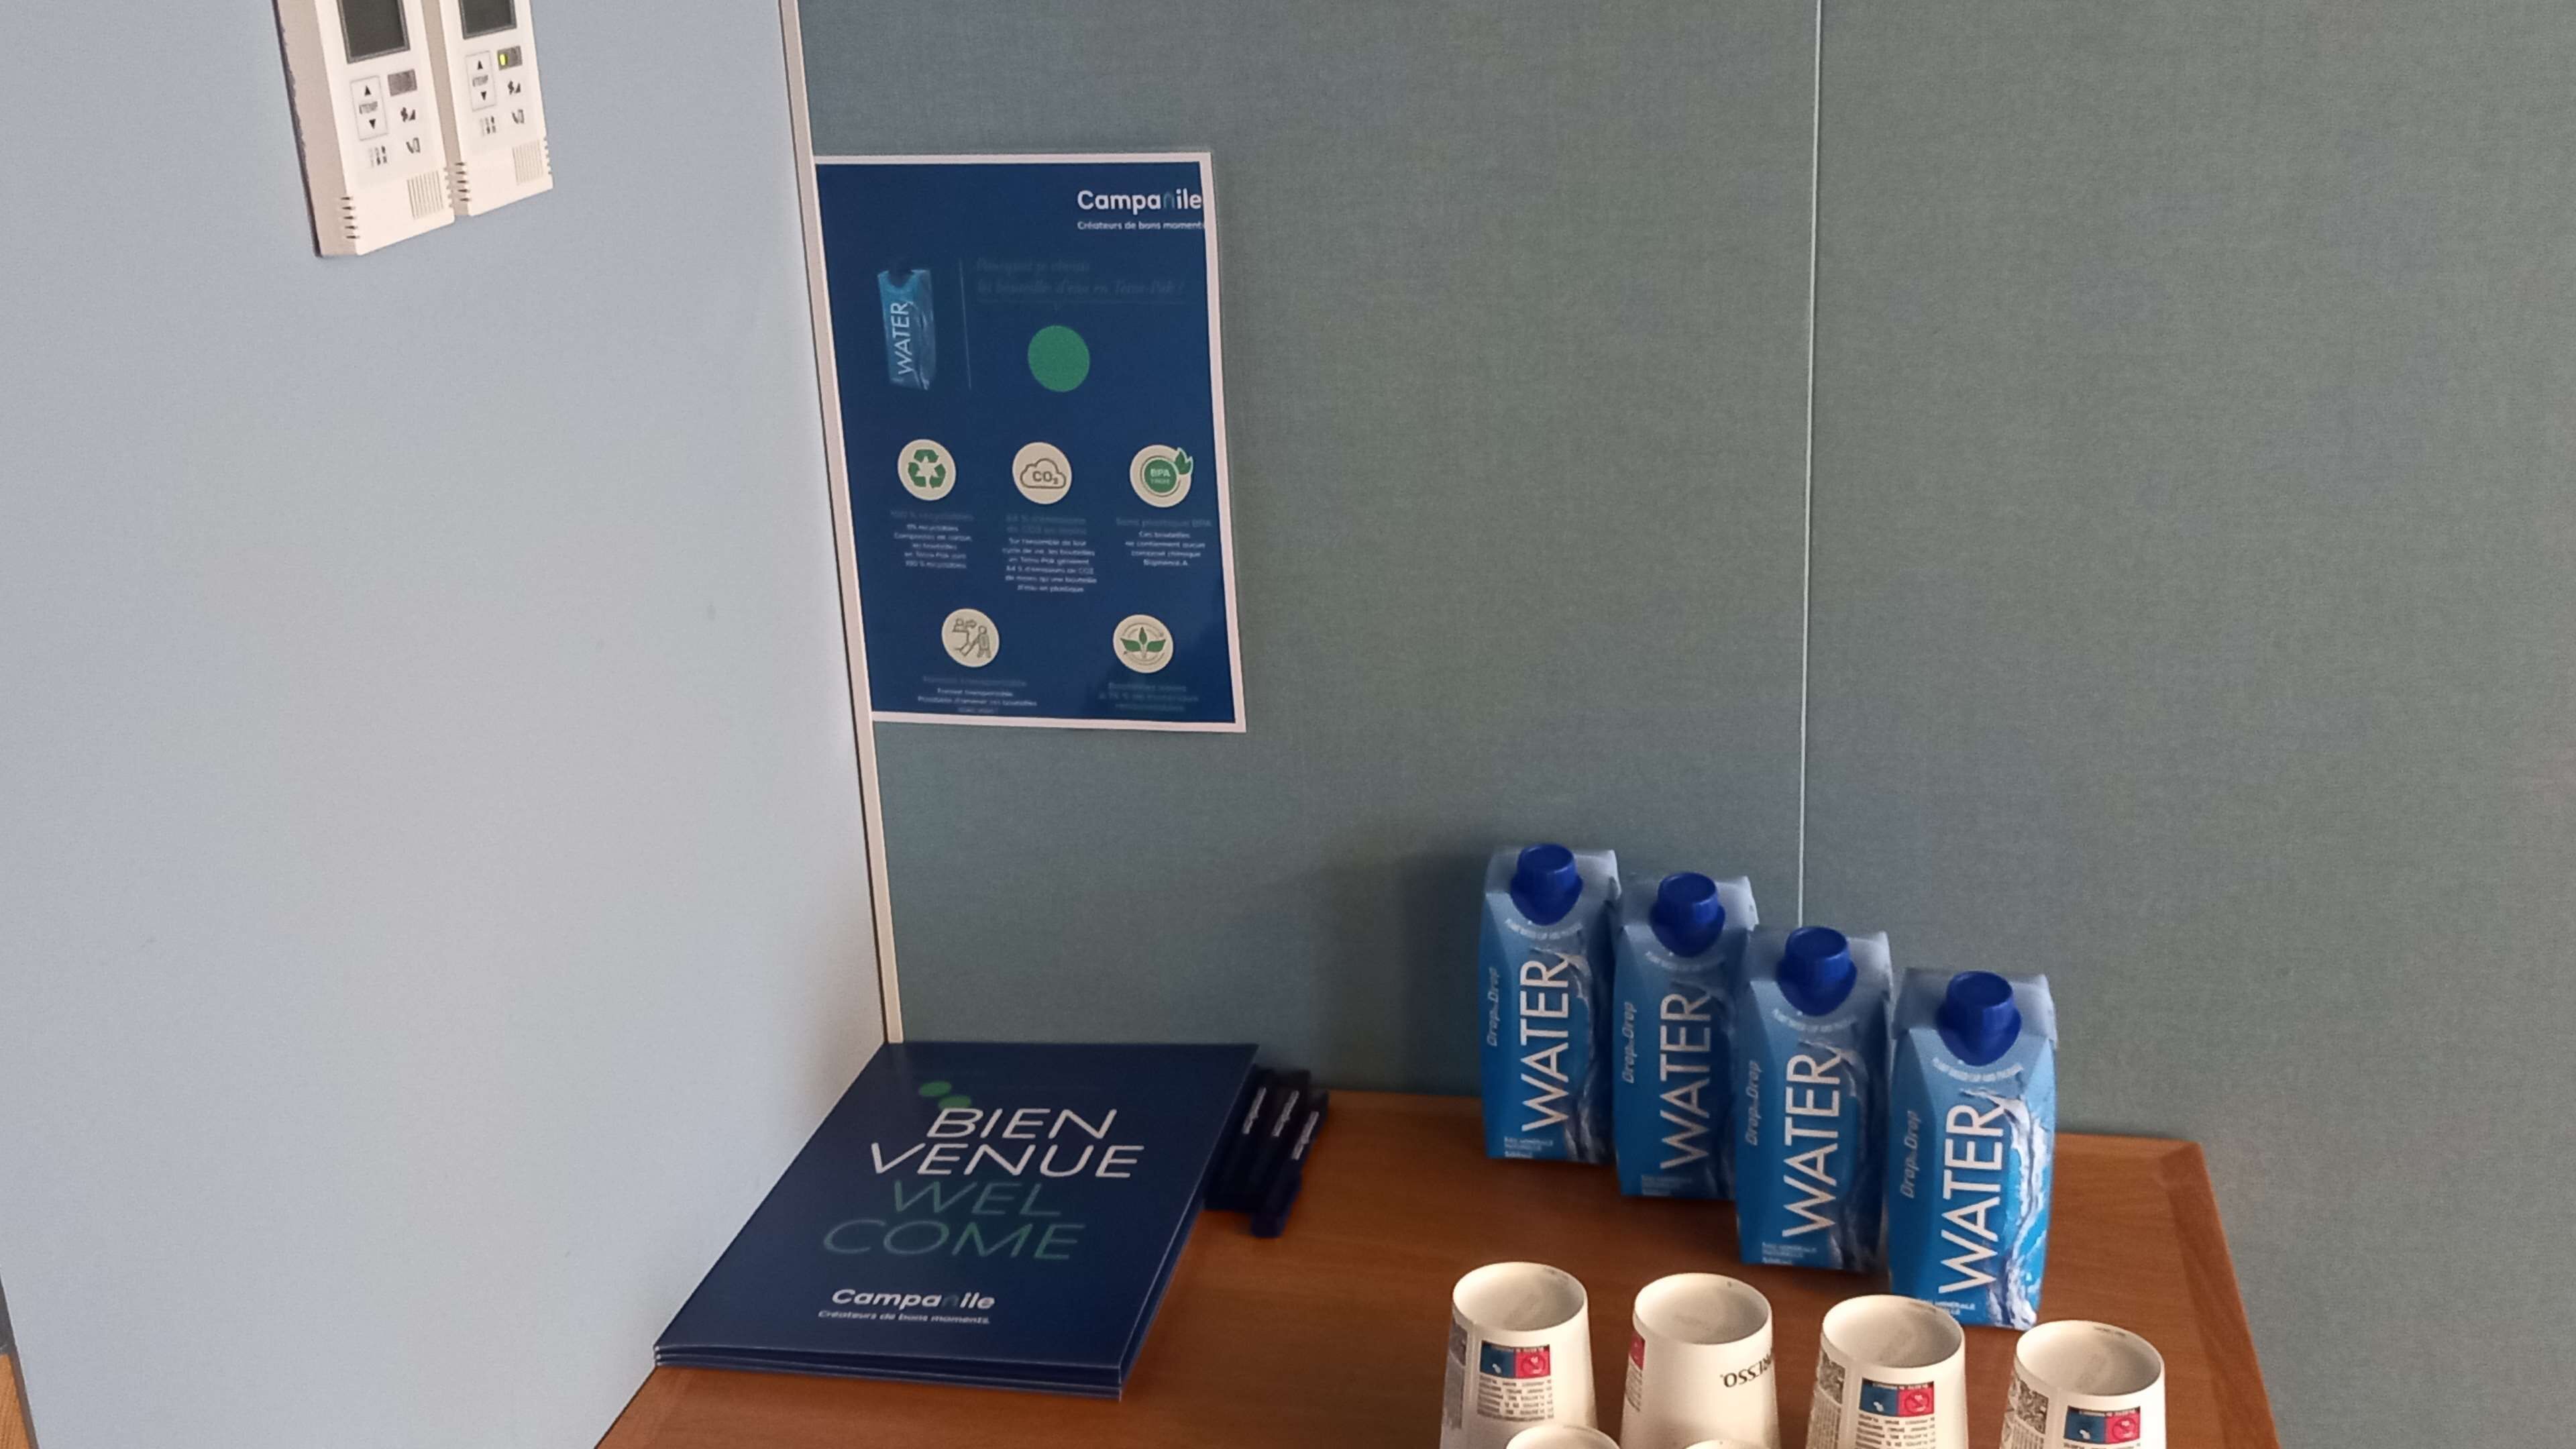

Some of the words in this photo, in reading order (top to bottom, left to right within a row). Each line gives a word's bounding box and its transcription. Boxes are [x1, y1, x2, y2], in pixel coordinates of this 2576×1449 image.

[1077, 188, 1202, 215] Campanile
[1124, 221, 1137, 230] de
[1138, 221, 1161, 230] bons
[891, 302, 913, 375] WATER
[1519, 960, 1569, 1132] WATER
[1659, 993, 1711, 1169] WATER
[927, 1108, 1118, 1140] BIEN
[871, 1143, 1144, 1178] VENUE
[1782, 1054, 1841, 1238] WATER
[893, 1180, 1063, 1218] WEL
[1938, 1104, 2005, 1294] WATER
[822, 1219, 1085, 1260] COME
[831, 1288, 996, 1310] Campanile
[879, 1312, 895, 1321] de
